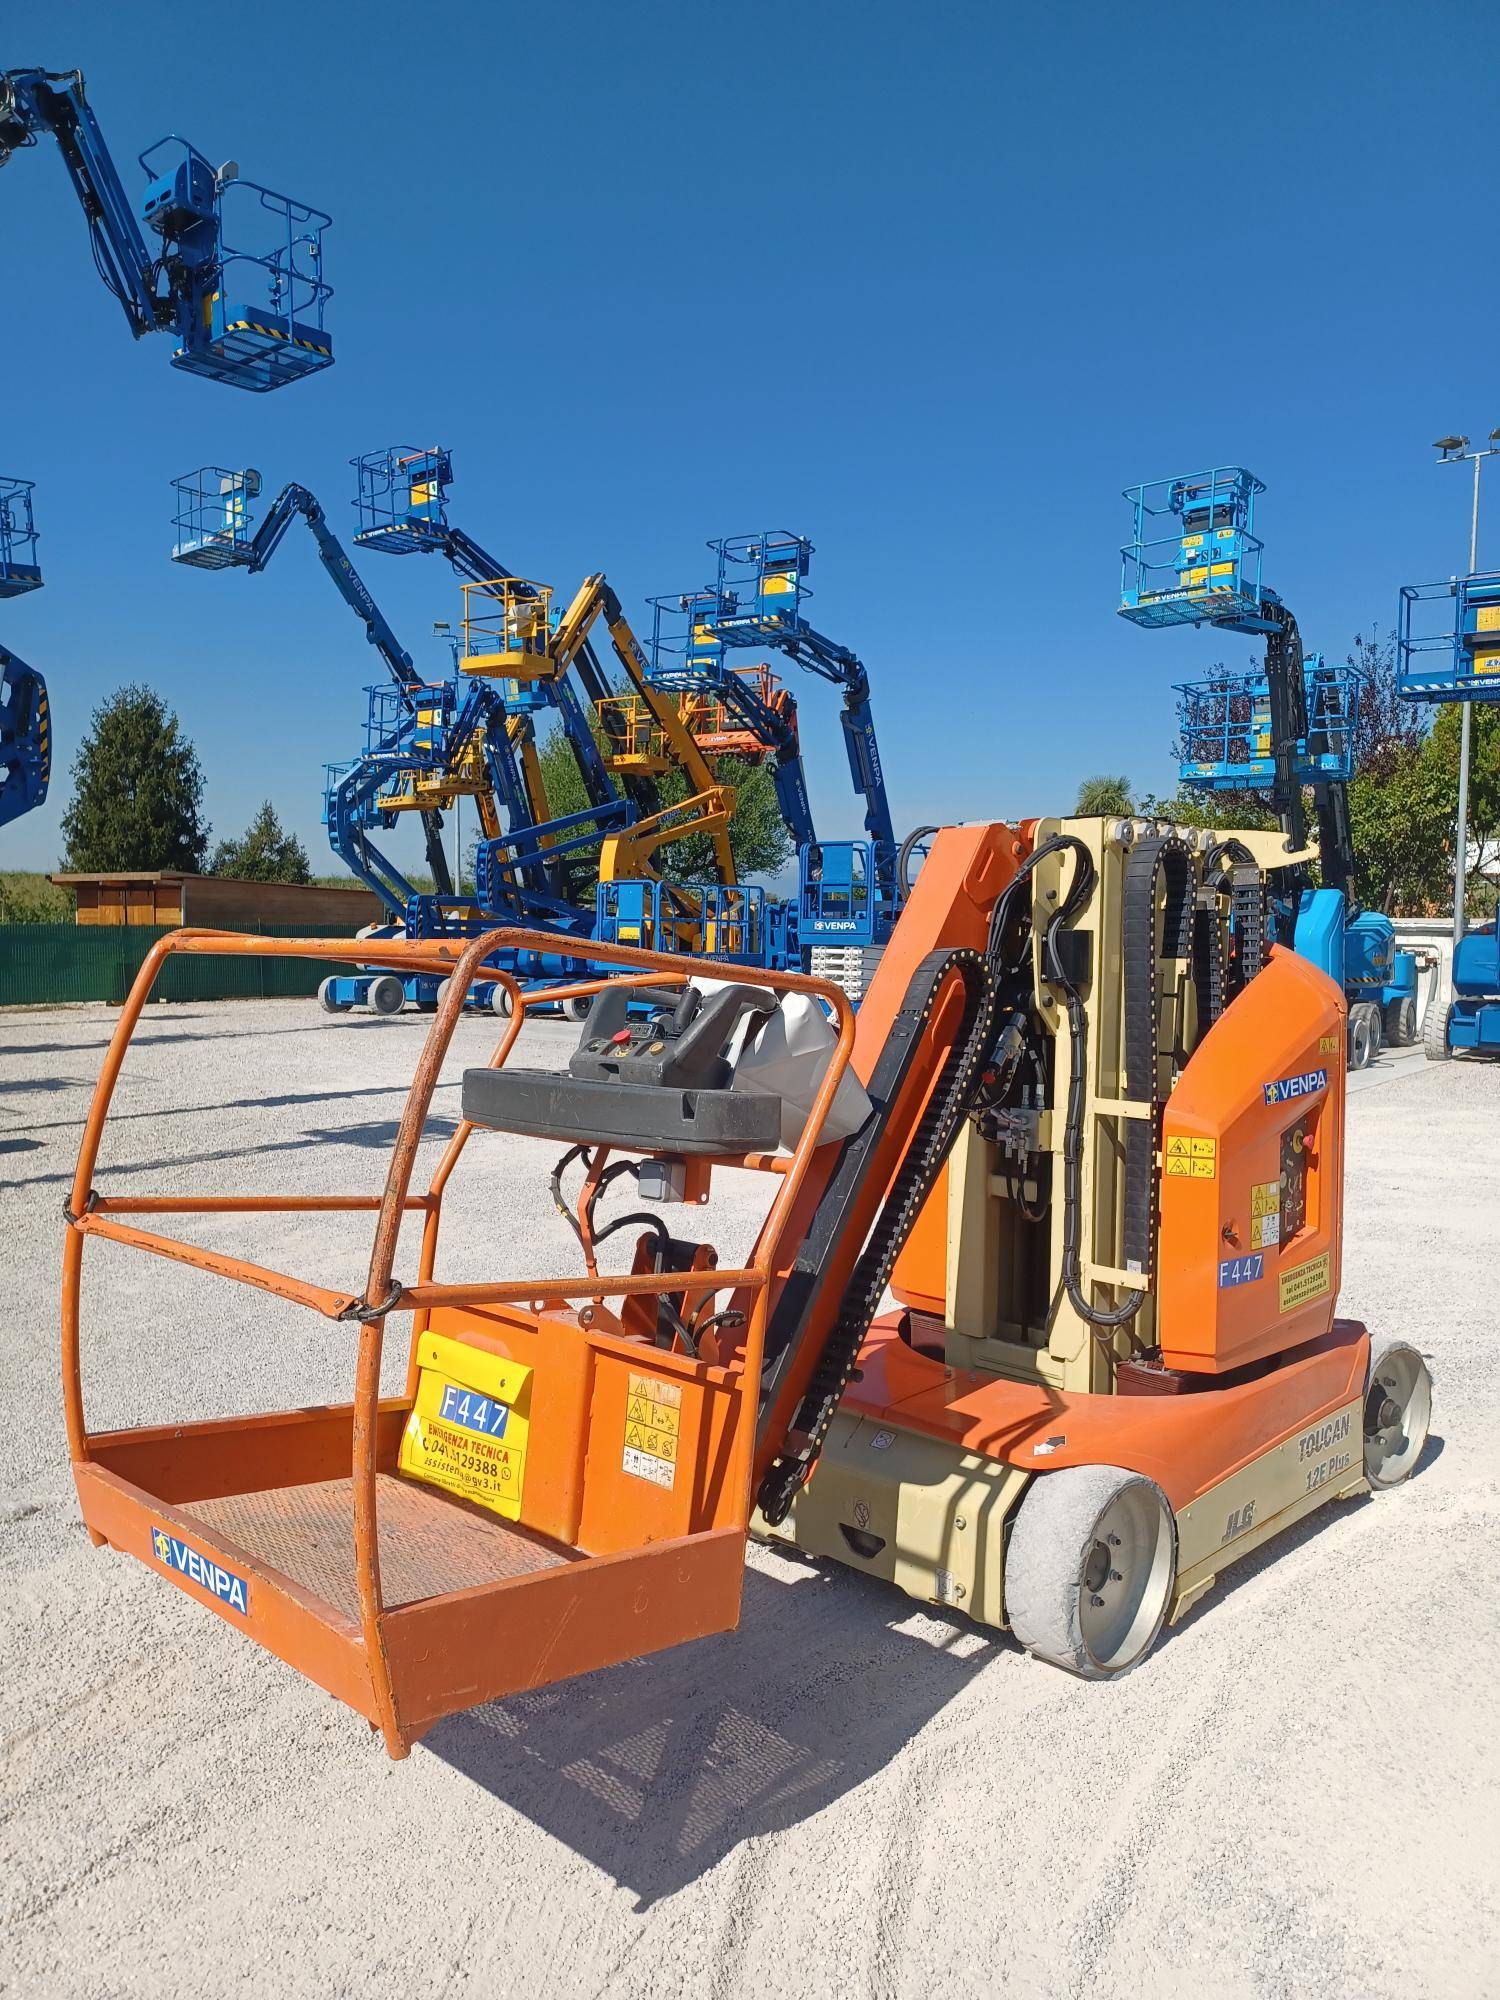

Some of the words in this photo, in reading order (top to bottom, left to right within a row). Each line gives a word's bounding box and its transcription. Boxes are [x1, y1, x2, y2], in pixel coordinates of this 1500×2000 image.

[349, 569, 374, 613] VENPA
[868, 735, 882, 787] VENPA
[824, 921, 857, 931] VENPA
[707, 954, 730, 963] VENPA
[1279, 1070, 1326, 1099] VENPA
[1220, 1254, 1263, 1287] F447
[442, 1387, 508, 1433] F447
[471, 1441, 509, 1464] TECNICA
[1299, 1413, 1351, 1463] TOUCAN
[1306, 1463, 1327, 1491] 12E
[1328, 1453, 1351, 1475] Plus
[1221, 1499, 1256, 1544] JLG
[171, 1539, 247, 1614] VENPA
